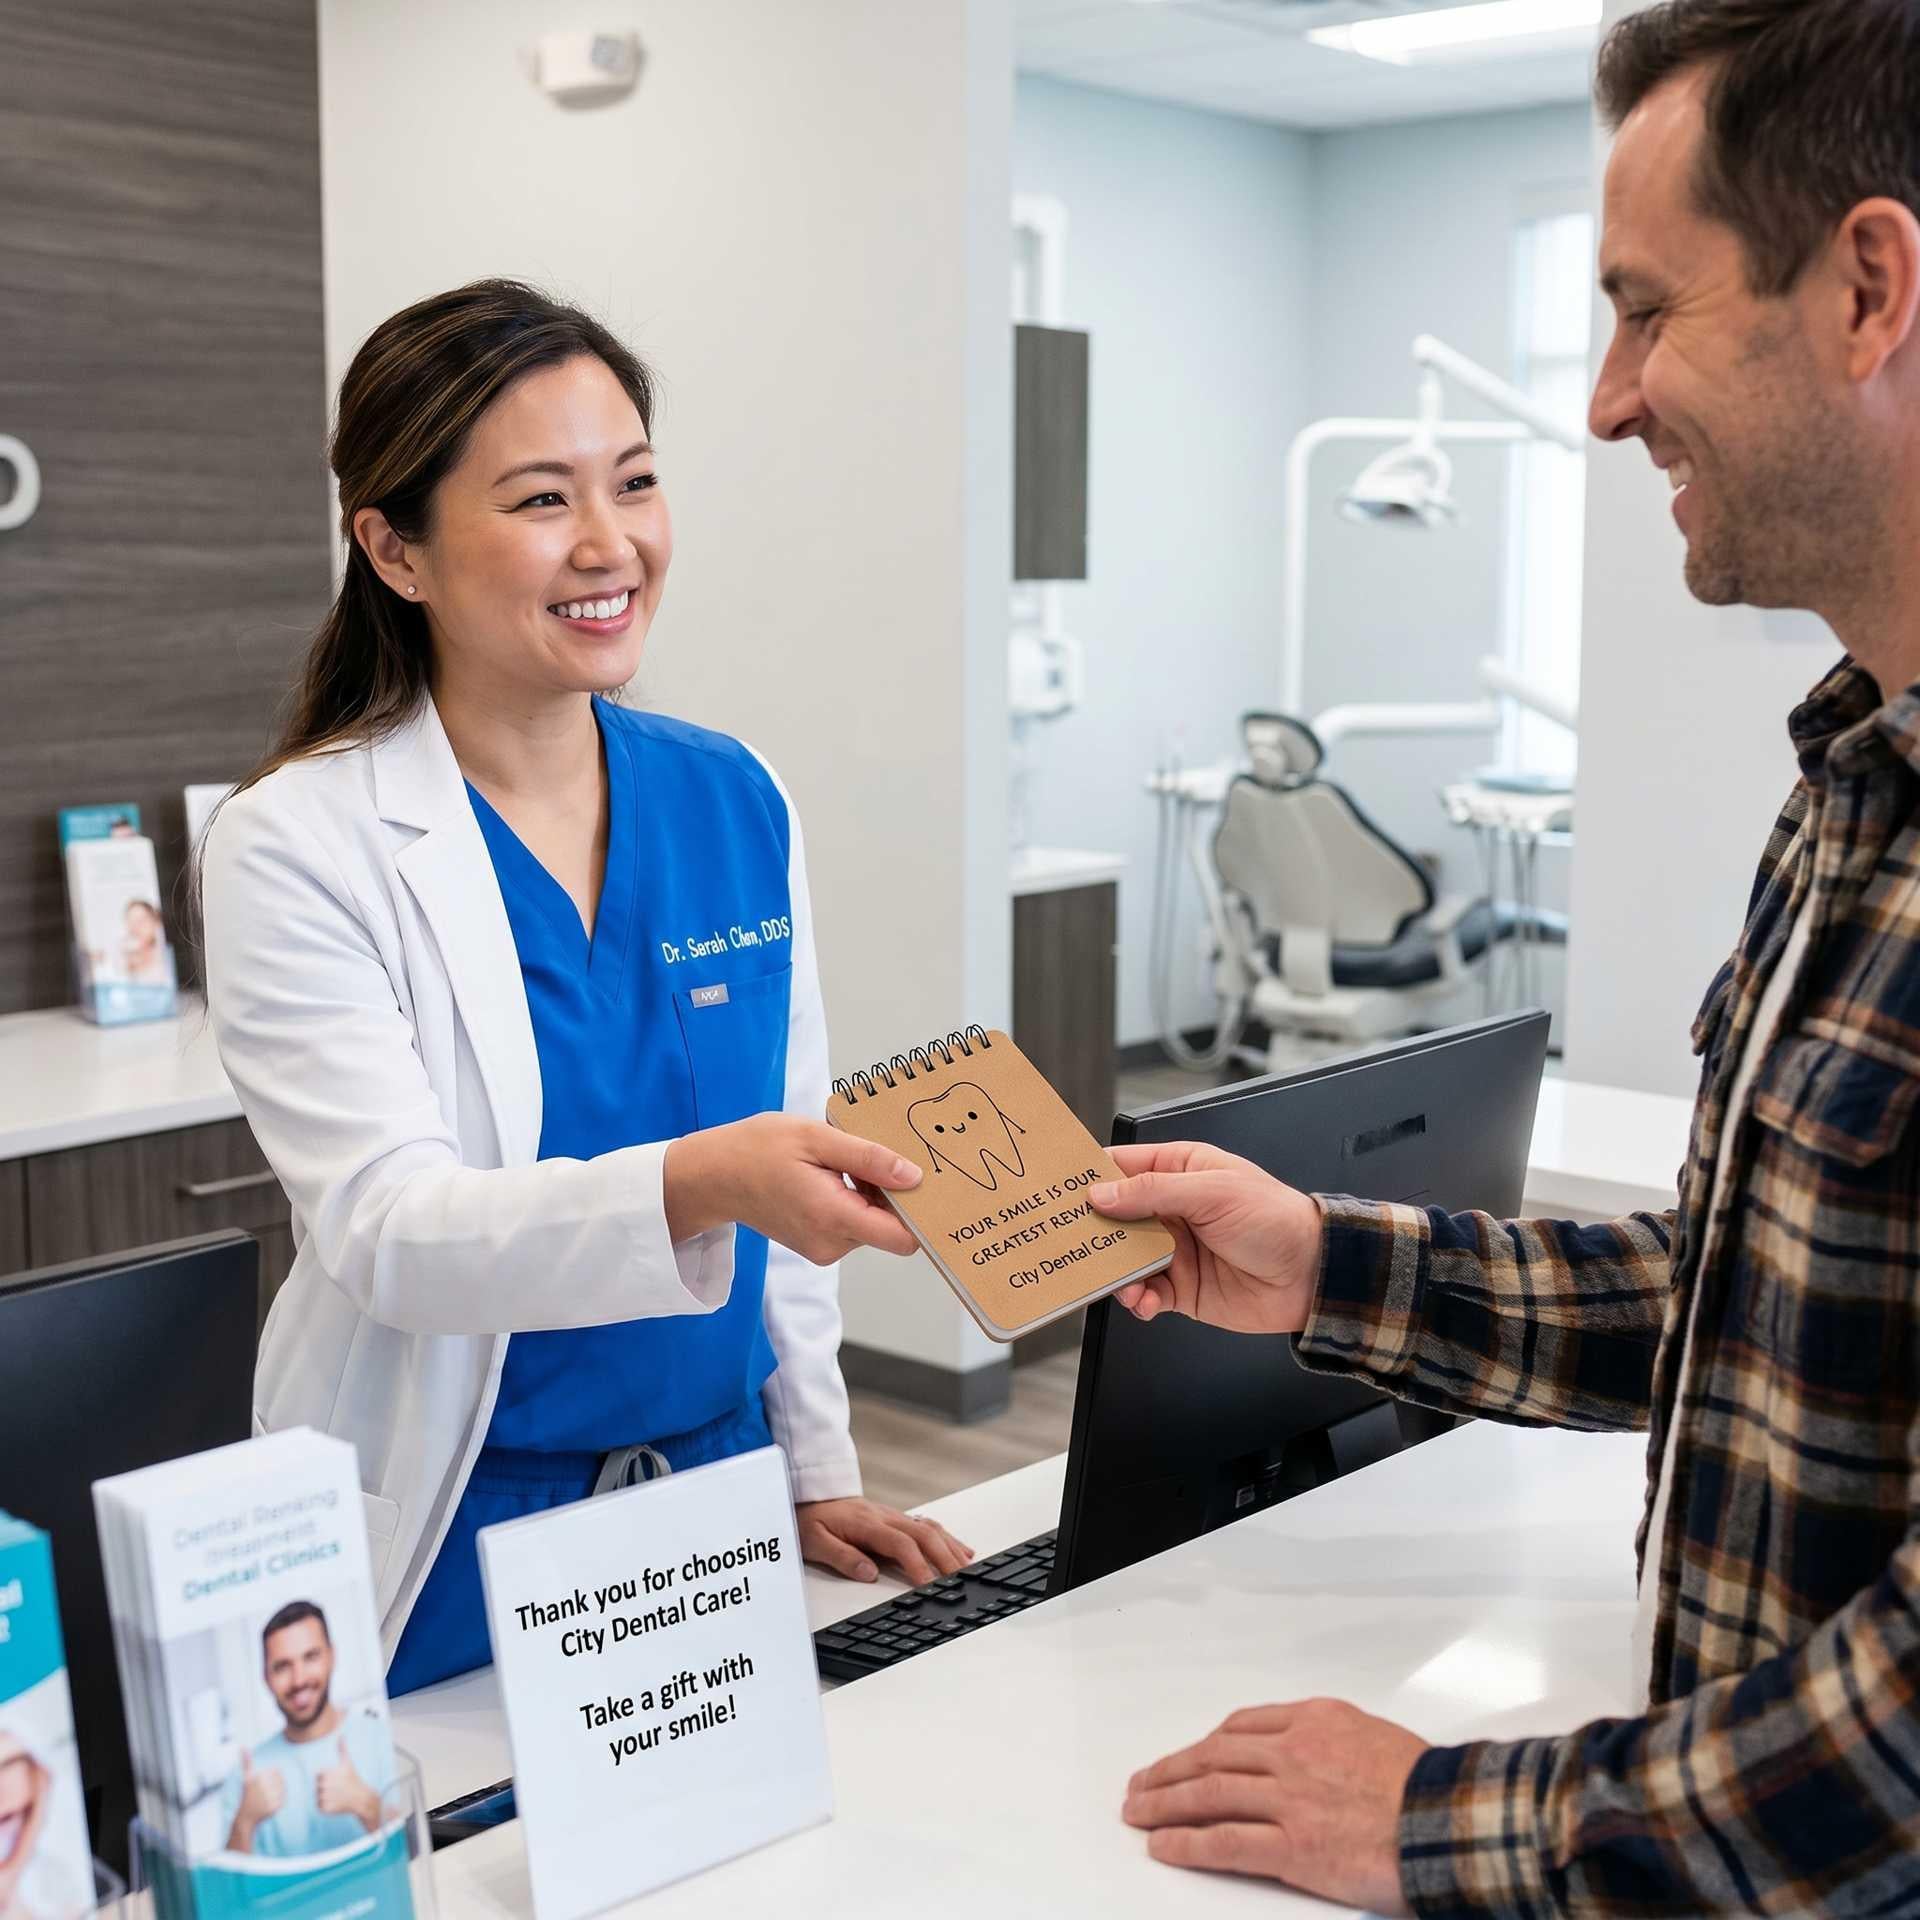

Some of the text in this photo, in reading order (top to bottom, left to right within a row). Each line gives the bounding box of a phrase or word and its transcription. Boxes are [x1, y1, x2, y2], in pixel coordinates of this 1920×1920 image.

[662, 942, 686, 964] Dr.
[687, 932, 728, 958] Sarah
[761, 916, 790, 942] DDS
[949, 1168, 1102, 1244] YOUR SMILE IS OUR
[971, 1200, 1094, 1266] GREATEST REWA
[1009, 1229, 1127, 1289] City Dental Care
[183, 1540, 341, 1602] Dental Clinics
[515, 1536, 781, 1631] Thank you for choosing
[561, 1576, 751, 1657] City Dental Care!
[579, 1652, 754, 1730] Take a gift with
[609, 1694, 737, 1766] your smile!
